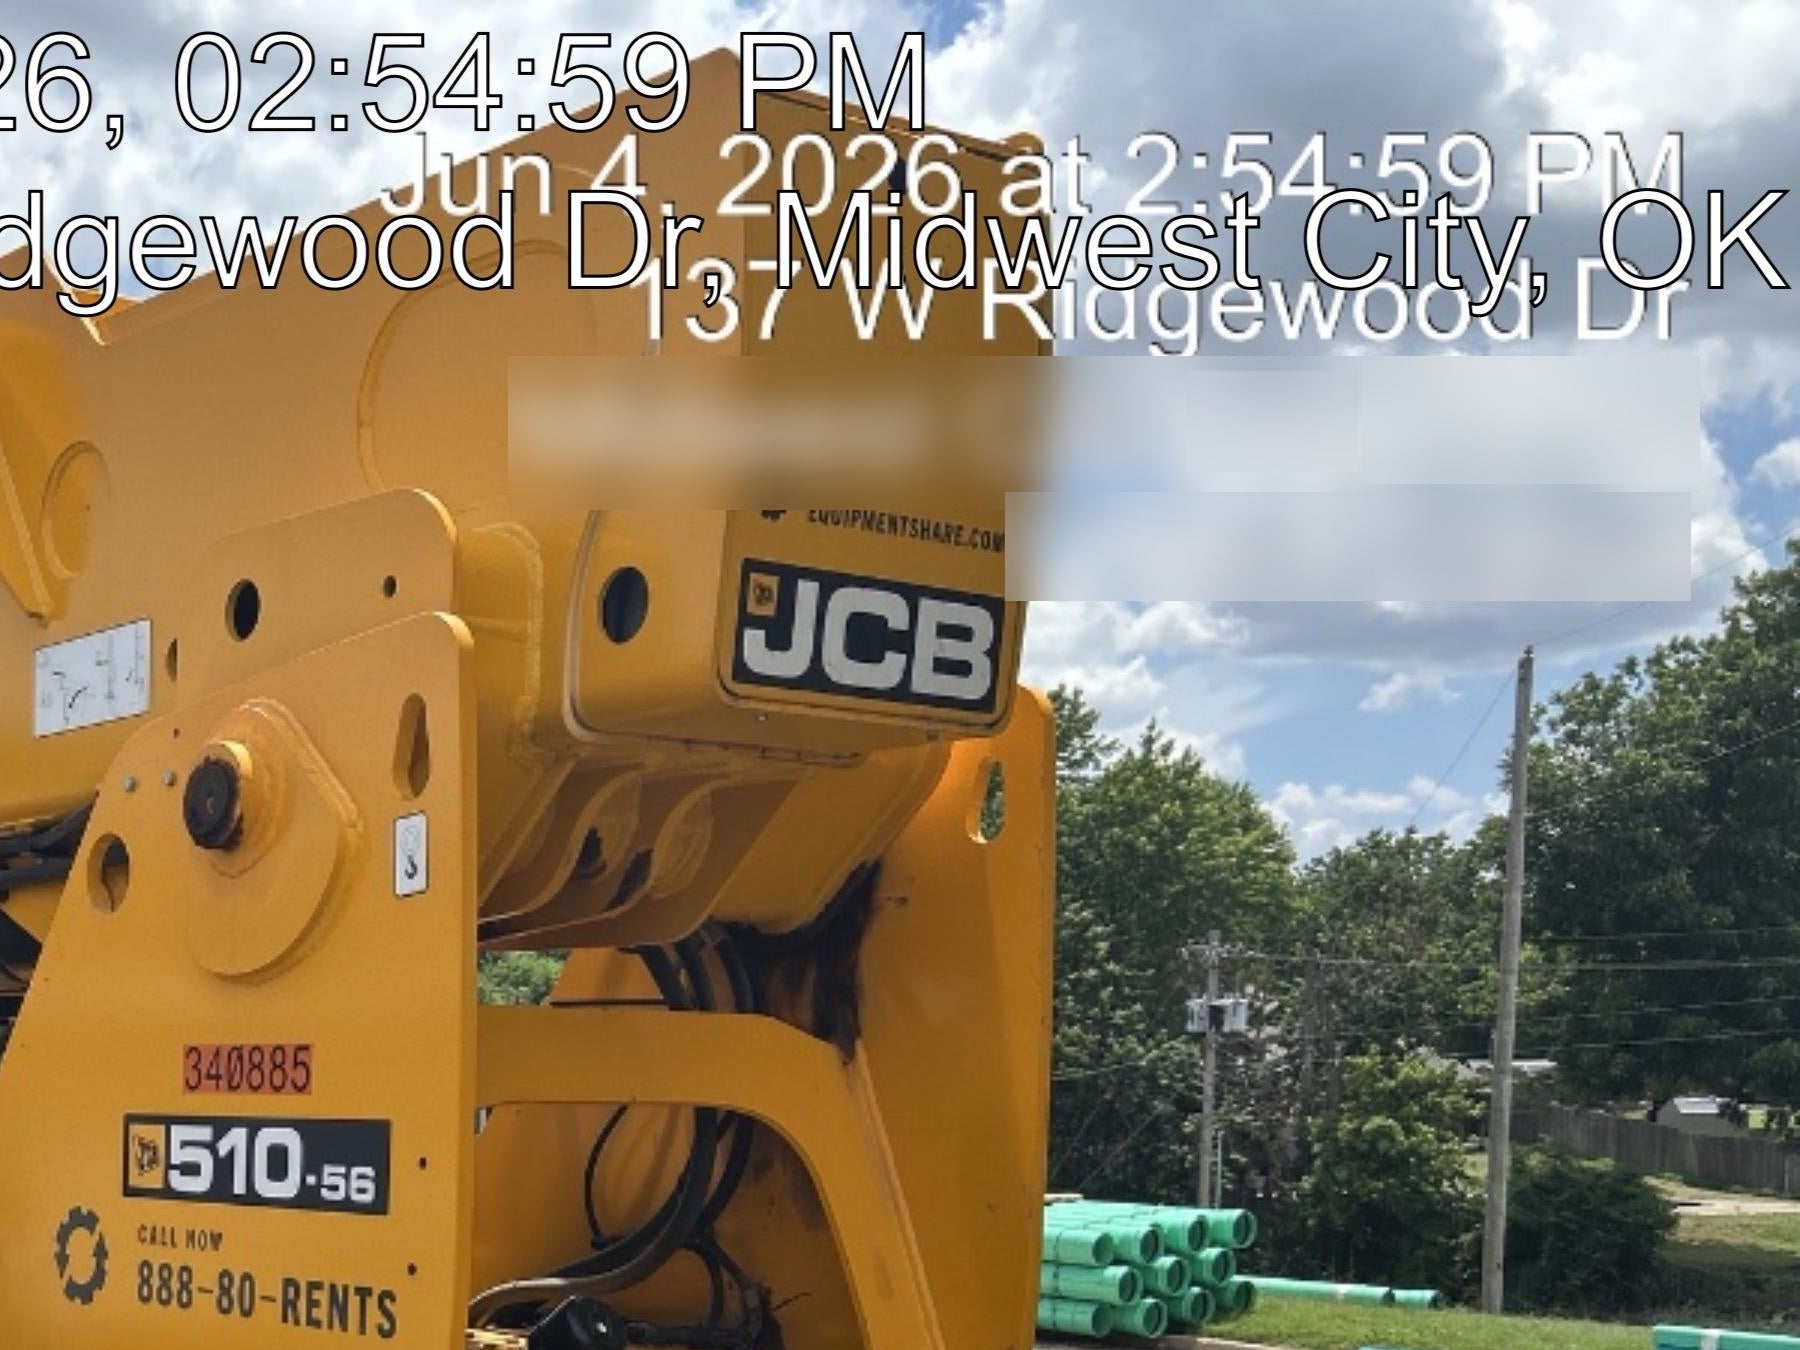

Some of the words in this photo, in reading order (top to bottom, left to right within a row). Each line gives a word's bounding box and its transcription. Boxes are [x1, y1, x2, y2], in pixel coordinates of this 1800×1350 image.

[742, 577, 996, 701] JCB
[183, 1043, 313, 1094] 340885
[137, 1223, 178, 1249] CALL
[185, 1228, 224, 1252] NOW
[136, 1258, 398, 1340] 888-80-RENTS
